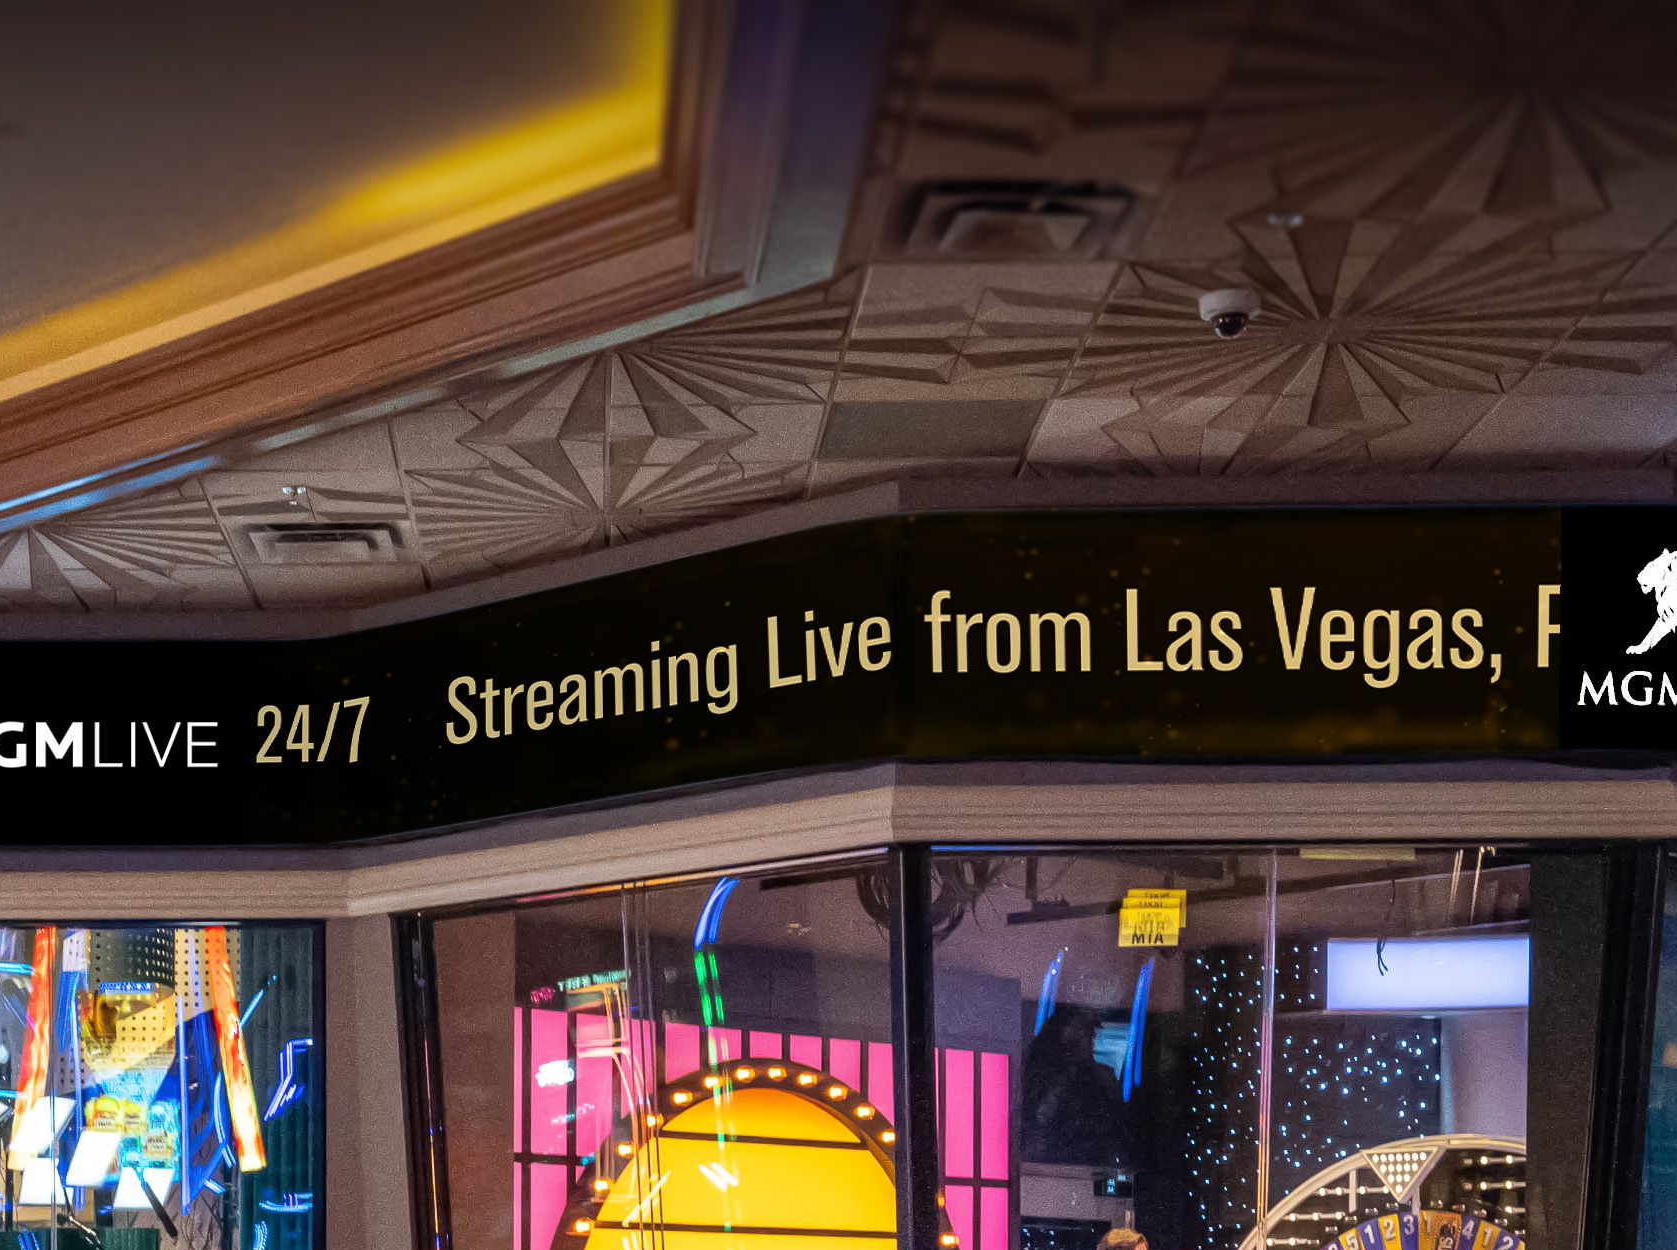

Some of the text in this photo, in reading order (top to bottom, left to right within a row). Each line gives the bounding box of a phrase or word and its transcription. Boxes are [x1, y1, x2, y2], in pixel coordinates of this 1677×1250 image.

[445, 640, 739, 745] Streaming
[766, 610, 893, 689] Live
[923, 589, 1093, 673] from
[1125, 587, 1244, 673] Las
[1269, 585, 1504, 689] Vegas,
[255, 695, 371, 765] 24/7
[1363, 1224, 1376, 1244] 1
[1383, 1219, 1396, 1241] 2
[1403, 1215, 1415, 1236] 3
[1462, 1220, 1475, 1240] 4
[1482, 1227, 1494, 1247] 1
